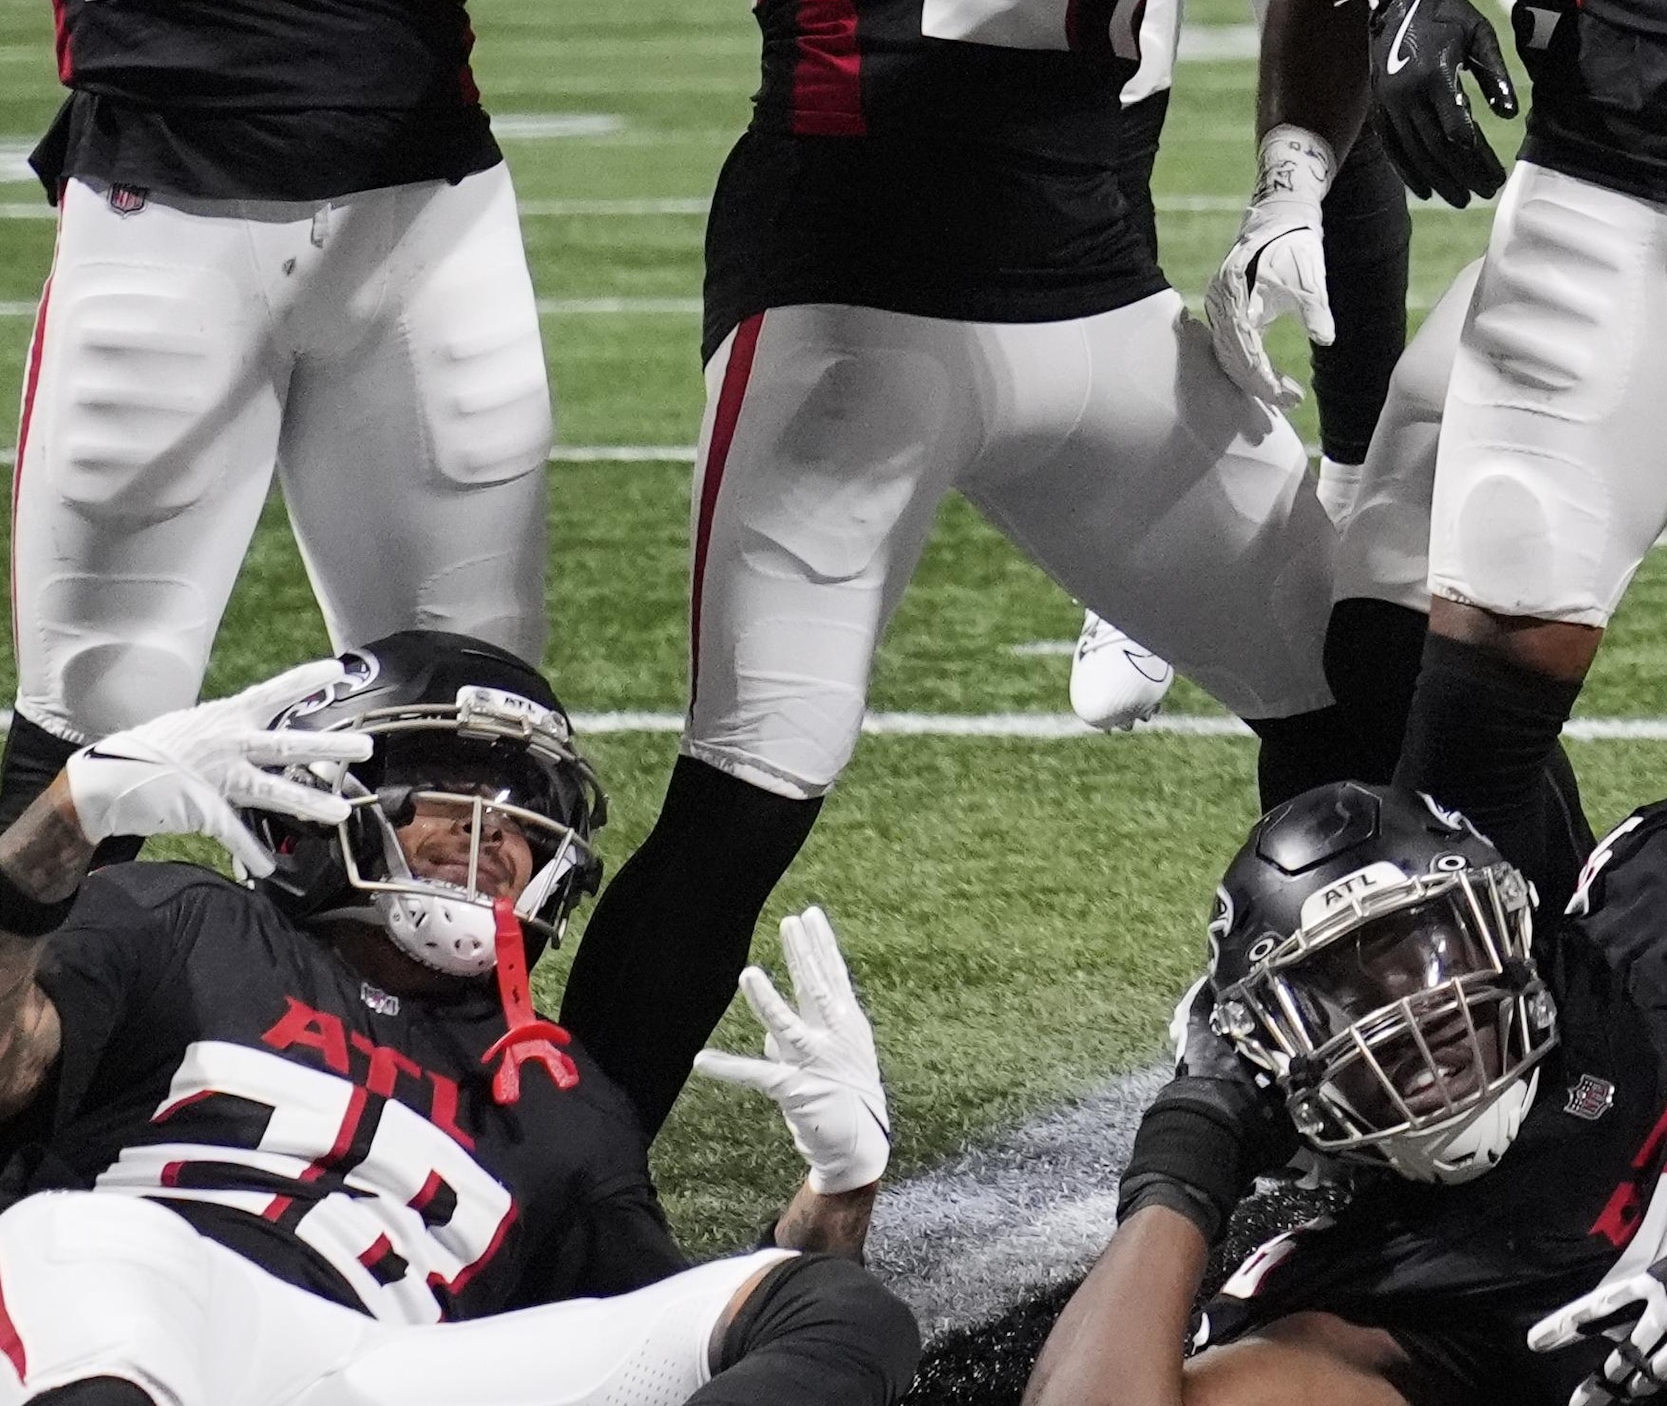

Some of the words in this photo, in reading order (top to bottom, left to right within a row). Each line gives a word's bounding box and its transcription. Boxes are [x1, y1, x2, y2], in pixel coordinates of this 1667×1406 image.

[503, 697, 537, 714] ATL
[1325, 873, 1377, 907] ATL
[260, 995, 476, 1152] ATL
[96, 1041, 519, 1325] 28
